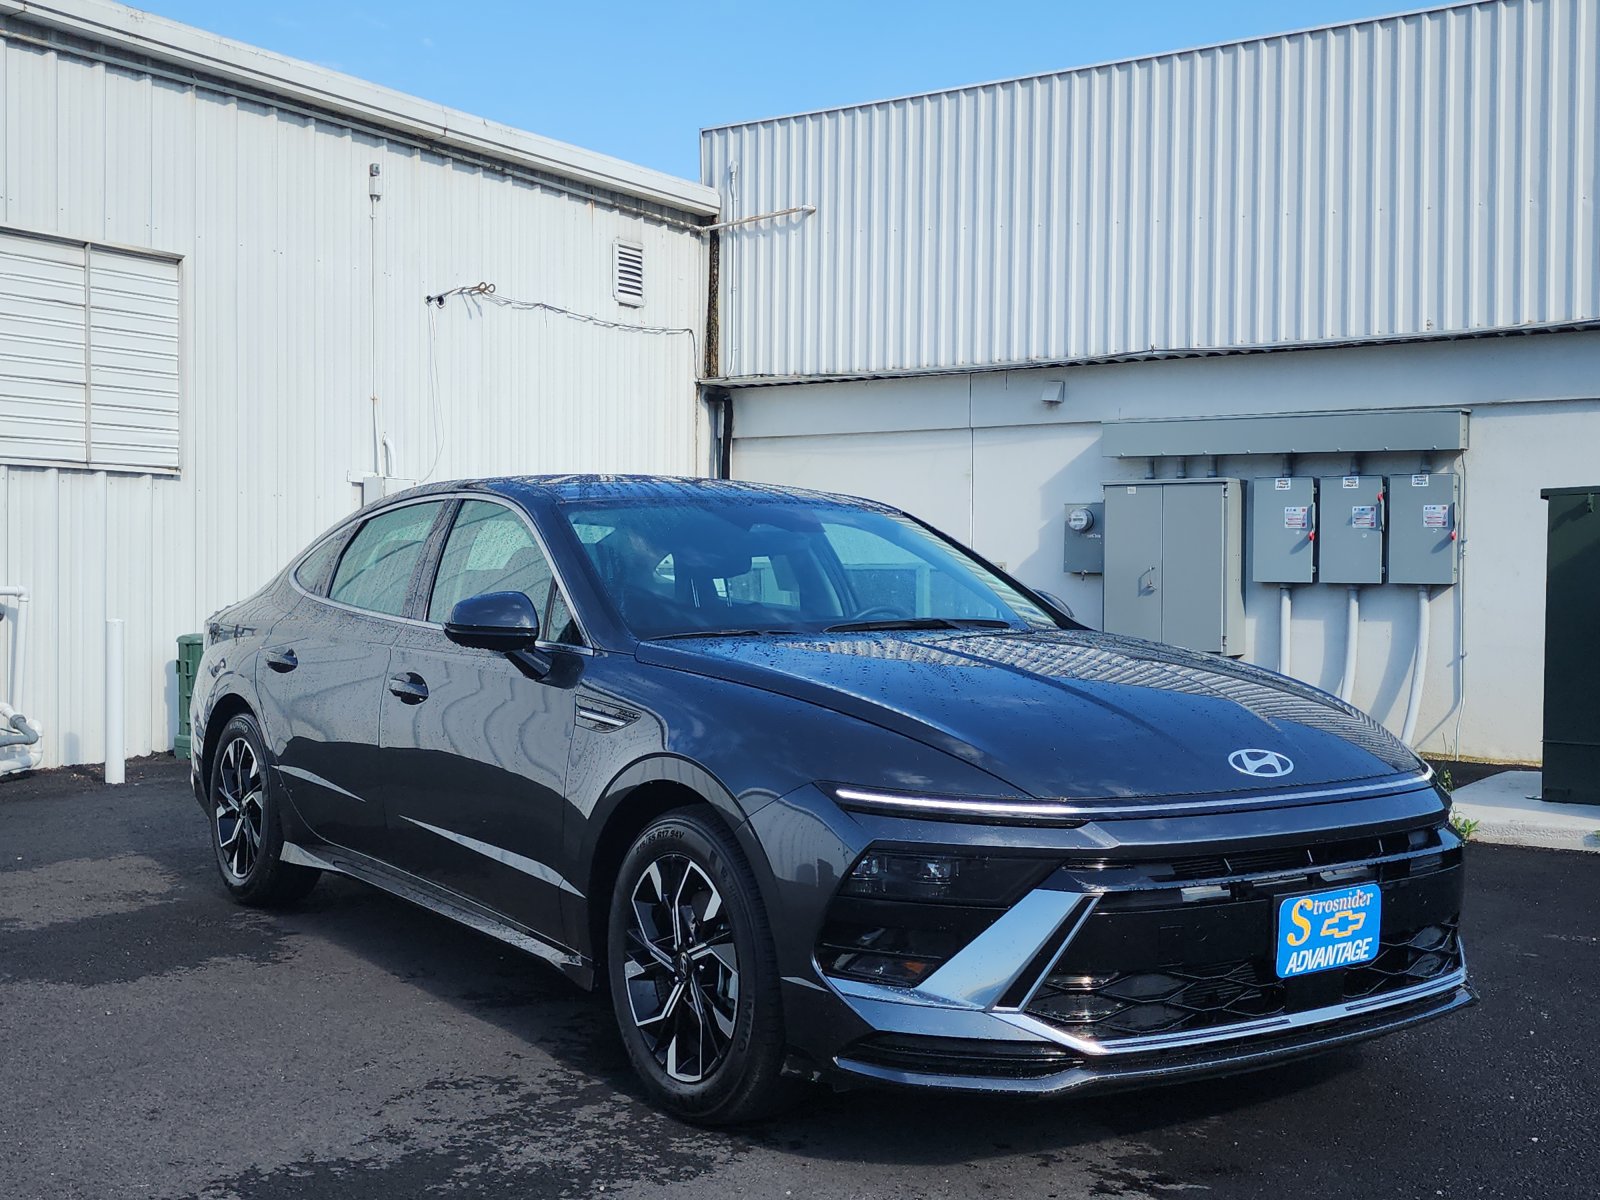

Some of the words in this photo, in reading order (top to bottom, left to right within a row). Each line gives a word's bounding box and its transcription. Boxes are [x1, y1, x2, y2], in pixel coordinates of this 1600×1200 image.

[656, 829, 669, 839] R17
[1287, 889, 1374, 946] Strosnider
[1285, 937, 1373, 974] ADVANTAGE
